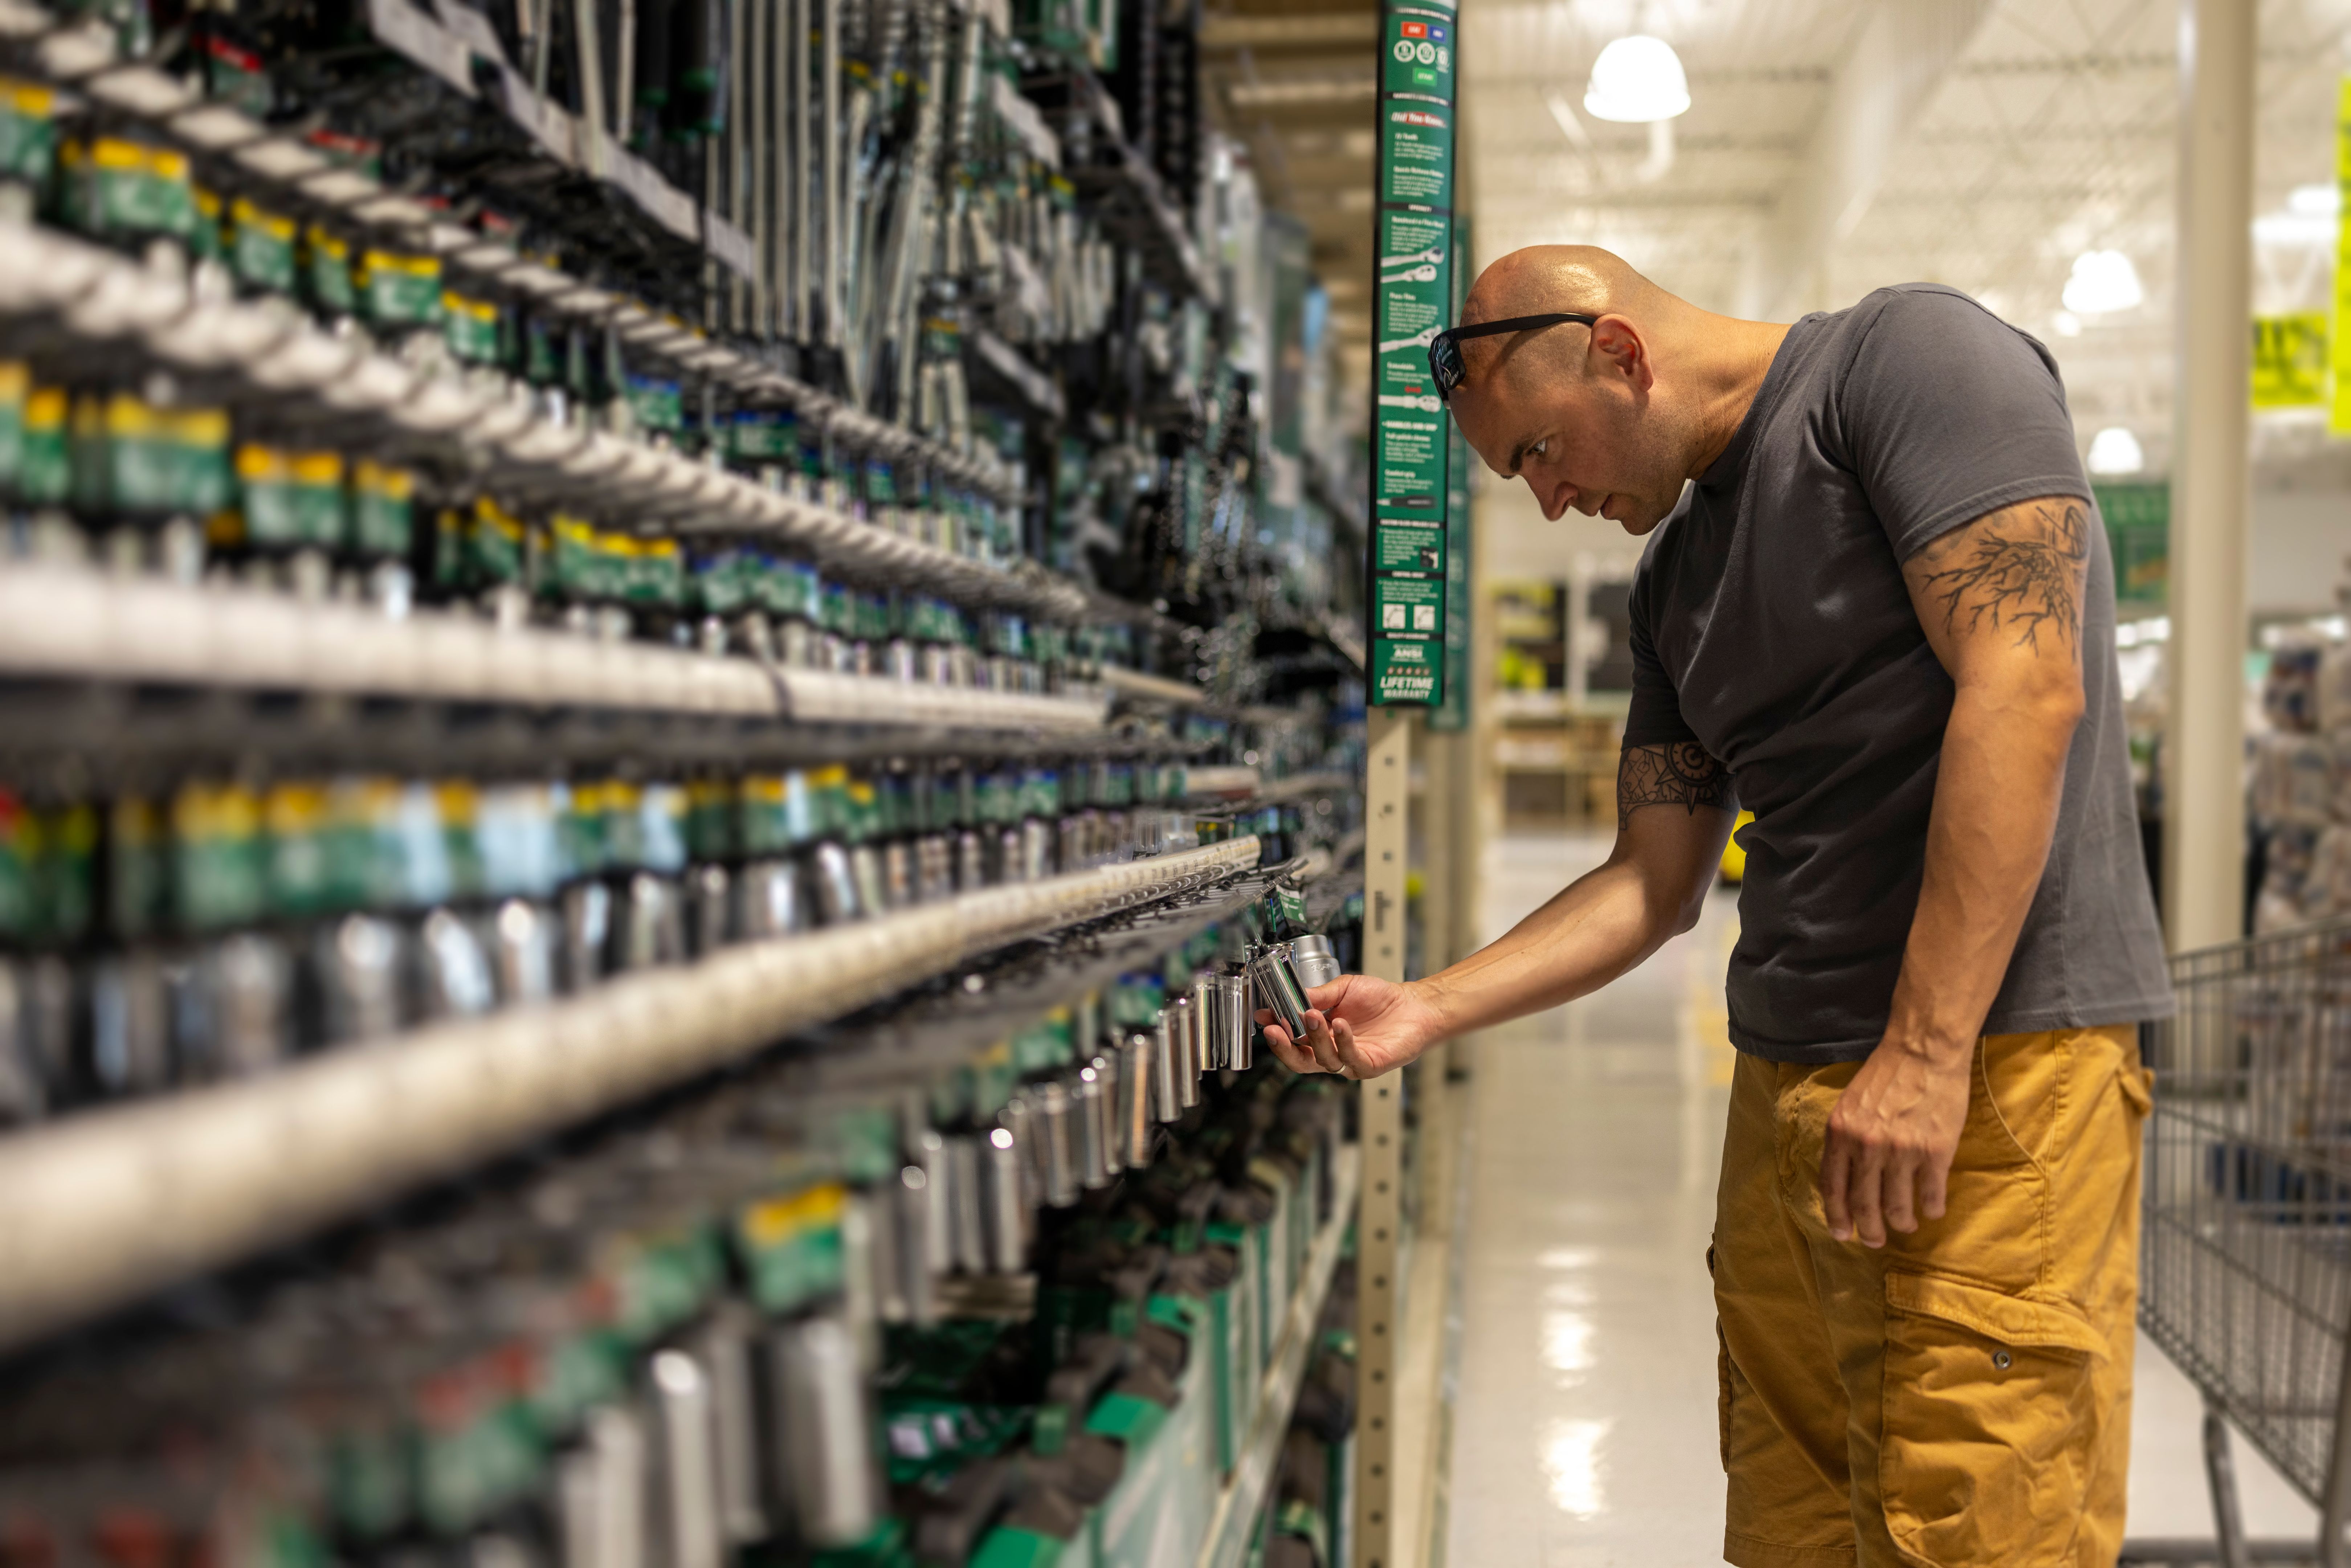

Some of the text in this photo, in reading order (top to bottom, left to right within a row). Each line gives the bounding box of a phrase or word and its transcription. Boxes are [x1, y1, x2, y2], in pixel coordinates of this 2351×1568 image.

[1393, 648, 1423, 658] ANSI
[1380, 676, 1434, 690] LIFETIME
[1383, 689, 1431, 700] WARRANTY
